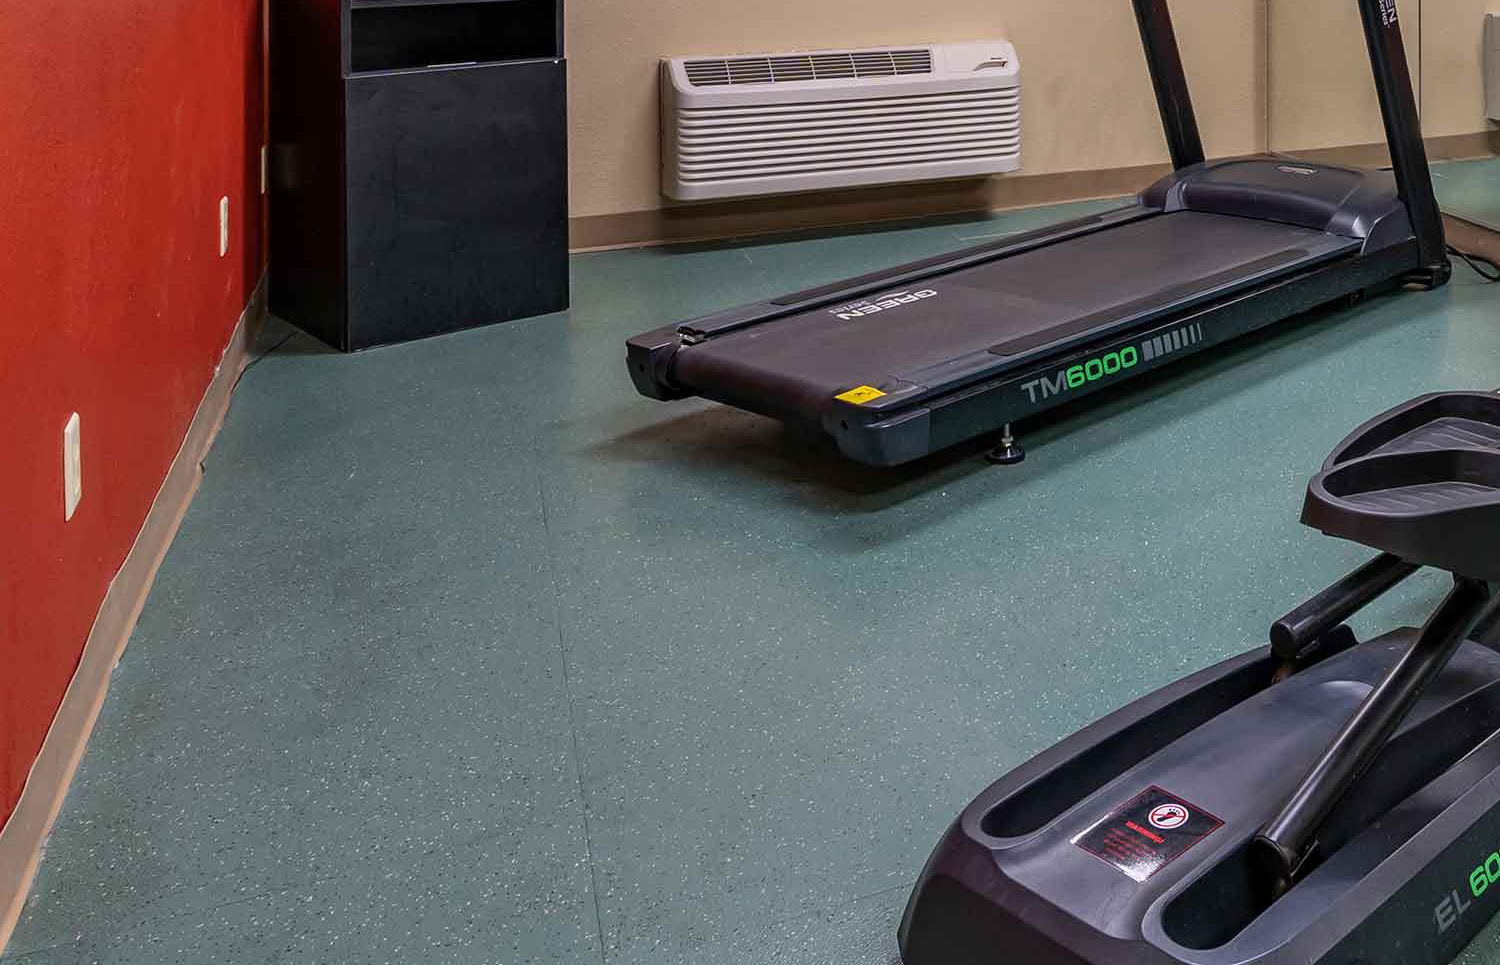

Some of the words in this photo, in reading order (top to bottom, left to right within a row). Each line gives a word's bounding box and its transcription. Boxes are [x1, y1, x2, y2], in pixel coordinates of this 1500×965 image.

[836, 289, 938, 321] GREEN
[1021, 346, 1148, 404] TM6000
[1434, 889, 1472, 934] EL
